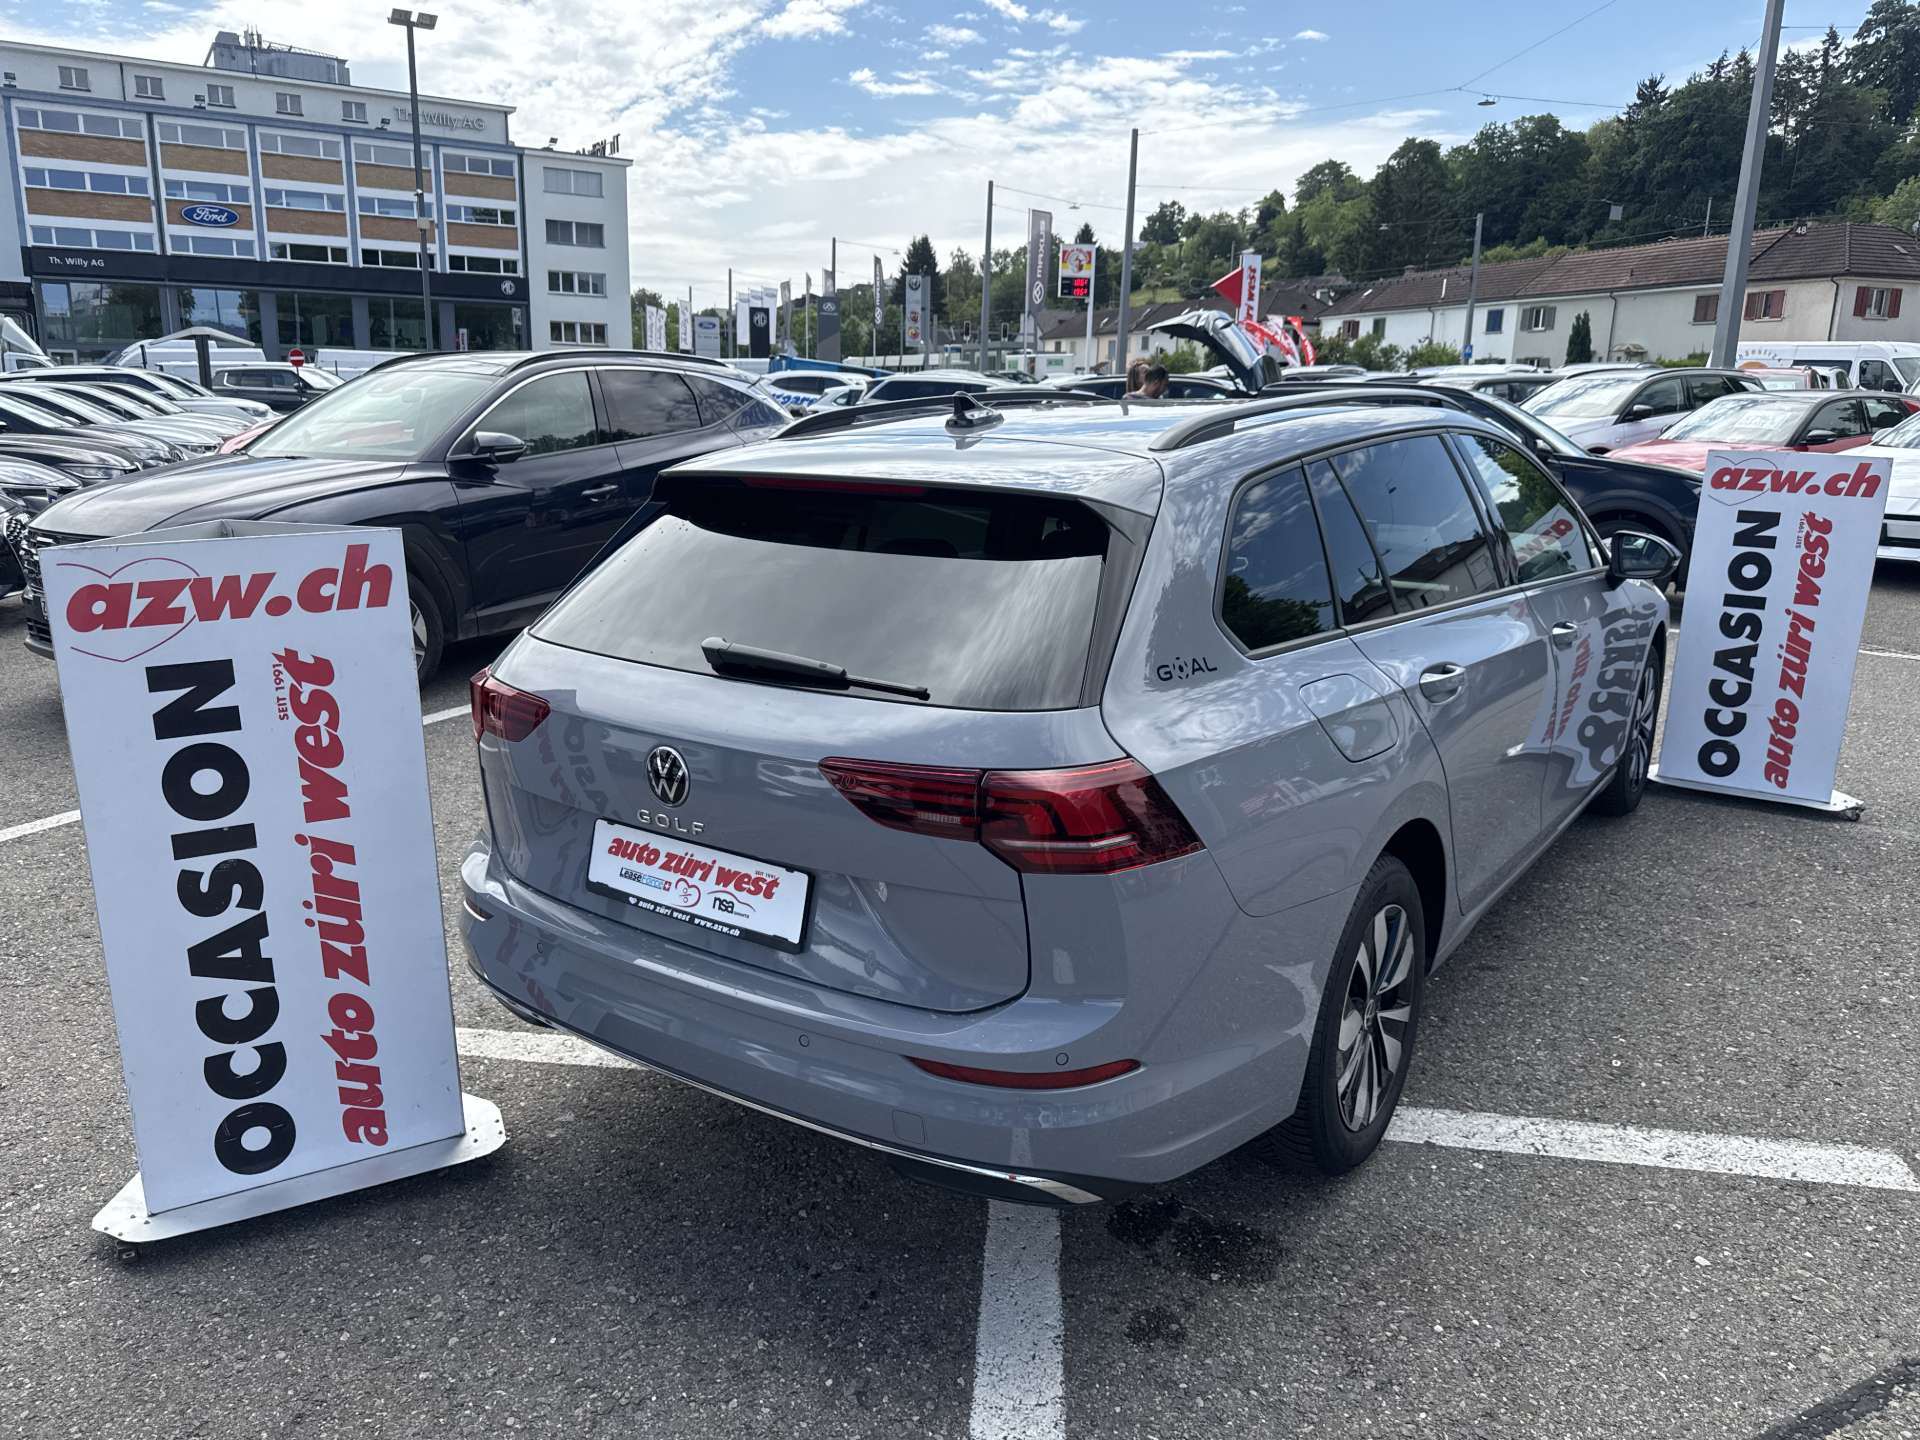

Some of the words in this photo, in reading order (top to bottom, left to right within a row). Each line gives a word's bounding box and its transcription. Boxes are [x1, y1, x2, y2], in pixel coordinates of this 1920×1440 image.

[423, 111, 458, 130] Willy
[463, 113, 486, 130] AG
[65, 257, 89, 268] Willy
[91, 258, 105, 268] AG
[1710, 463, 1882, 498] azw.ch
[68, 545, 391, 632] azw.ch
[1793, 511, 1833, 607] west
[1697, 510, 1782, 778] OCCASION
[1777, 608, 1816, 700] züri
[272, 648, 349, 823] west
[276, 696, 289, 721] SEIT
[1764, 698, 1800, 789] auto
[636, 808, 706, 836] GOLF
[293, 834, 370, 985] züri
[607, 837, 661, 866] auto
[658, 852, 716, 882] züri
[715, 866, 780, 900] west
[638, 900, 655, 910] auto
[672, 911, 691, 921] west
[713, 896, 735, 914] nsa
[146, 658, 297, 1176] OCCASION
[321, 995, 388, 1147] auto
